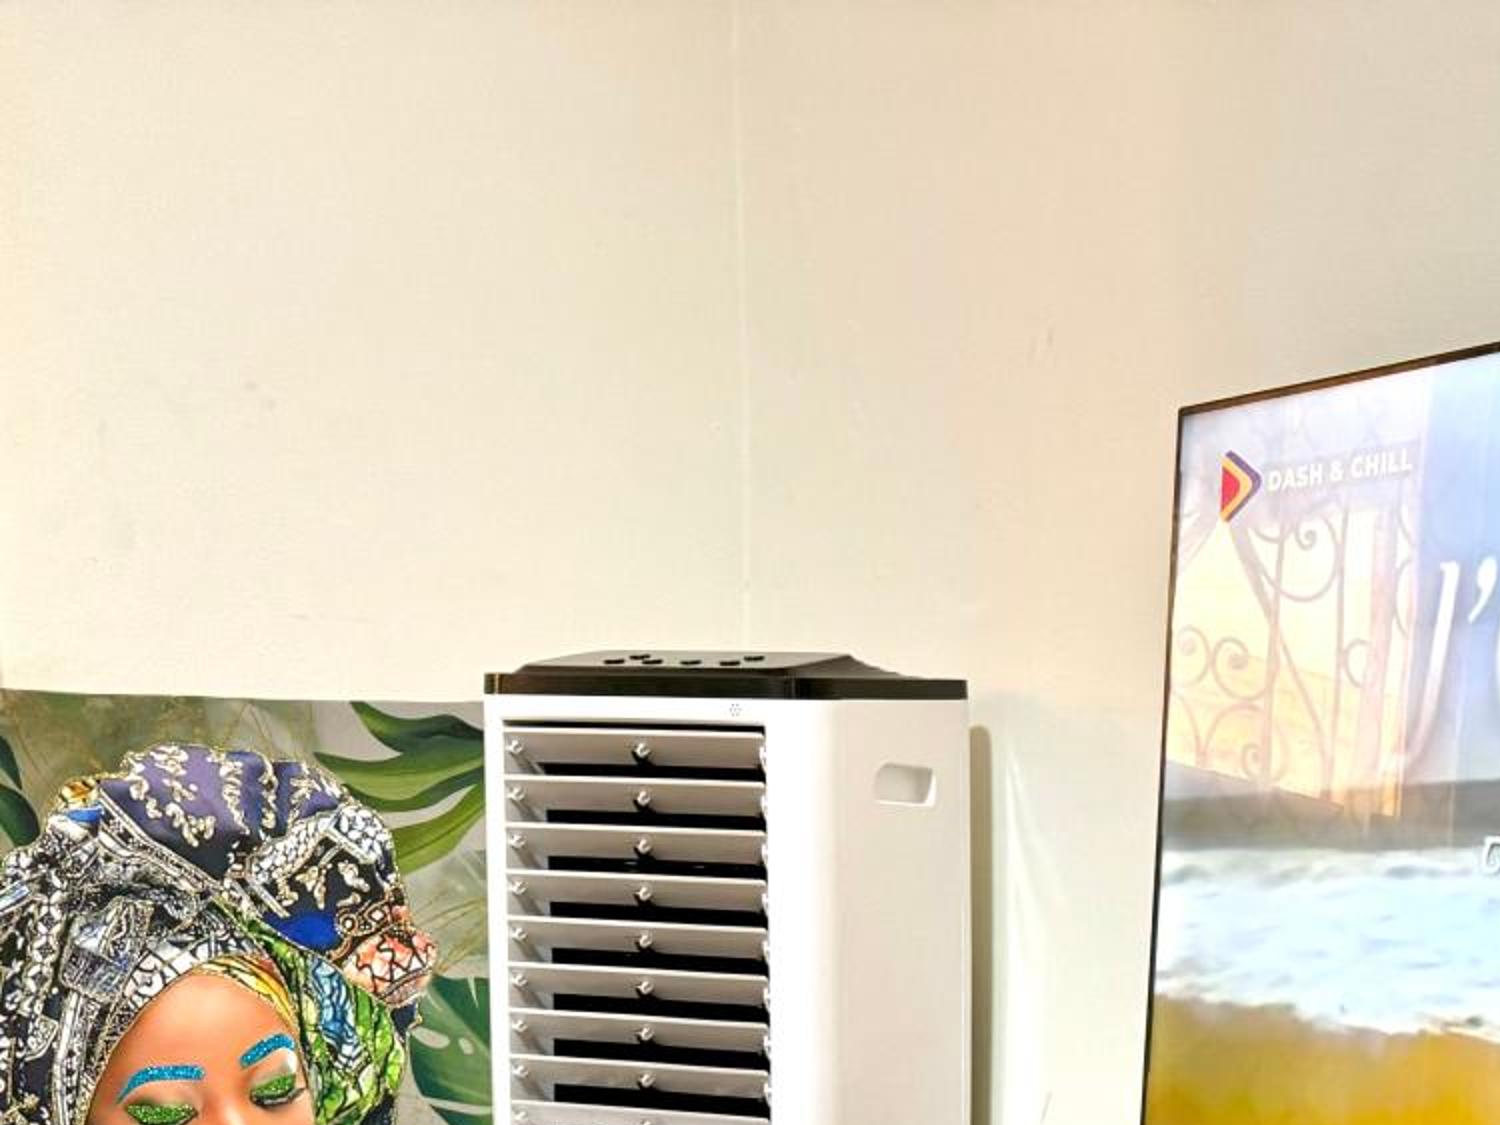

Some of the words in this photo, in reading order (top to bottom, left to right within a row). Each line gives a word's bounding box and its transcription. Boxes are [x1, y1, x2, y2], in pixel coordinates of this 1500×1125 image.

[1267, 463, 1323, 492] DASH
[1330, 459, 1345, 482] &
[1351, 448, 1413, 478] CHILL
